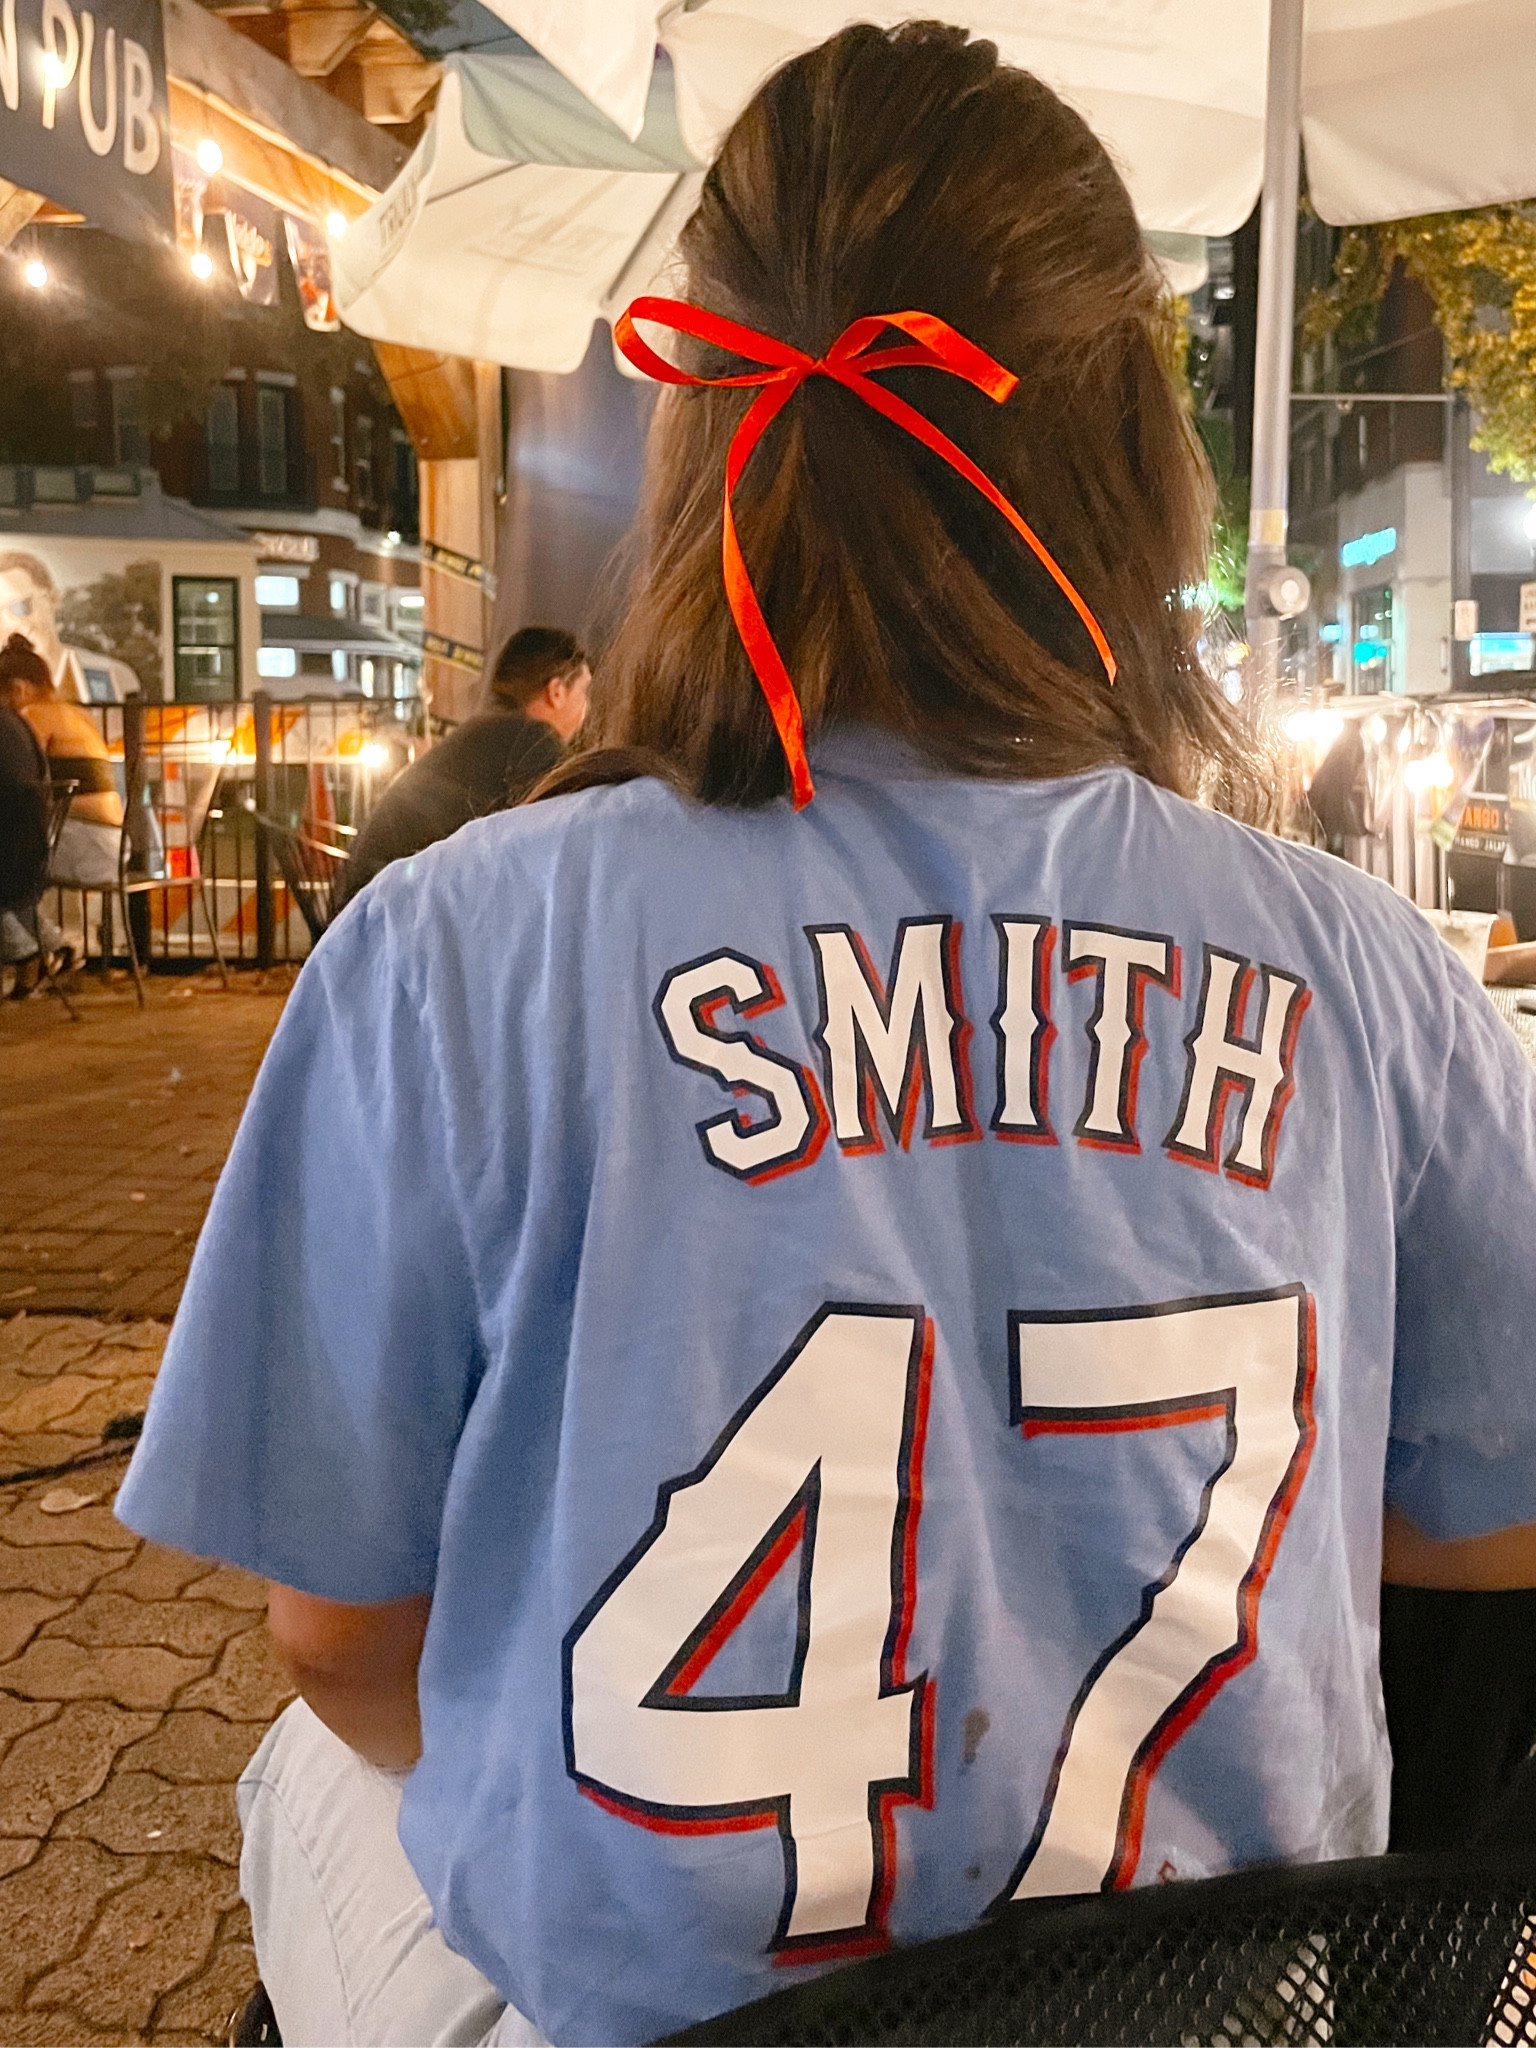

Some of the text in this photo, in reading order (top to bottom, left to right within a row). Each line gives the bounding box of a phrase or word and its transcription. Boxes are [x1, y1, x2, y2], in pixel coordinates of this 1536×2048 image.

[42, 0, 161, 175] PUB
[1460, 804, 1500, 830] ANGO
[652, 914, 1313, 1192] SMITH
[561, 1282, 1317, 1967] 47
